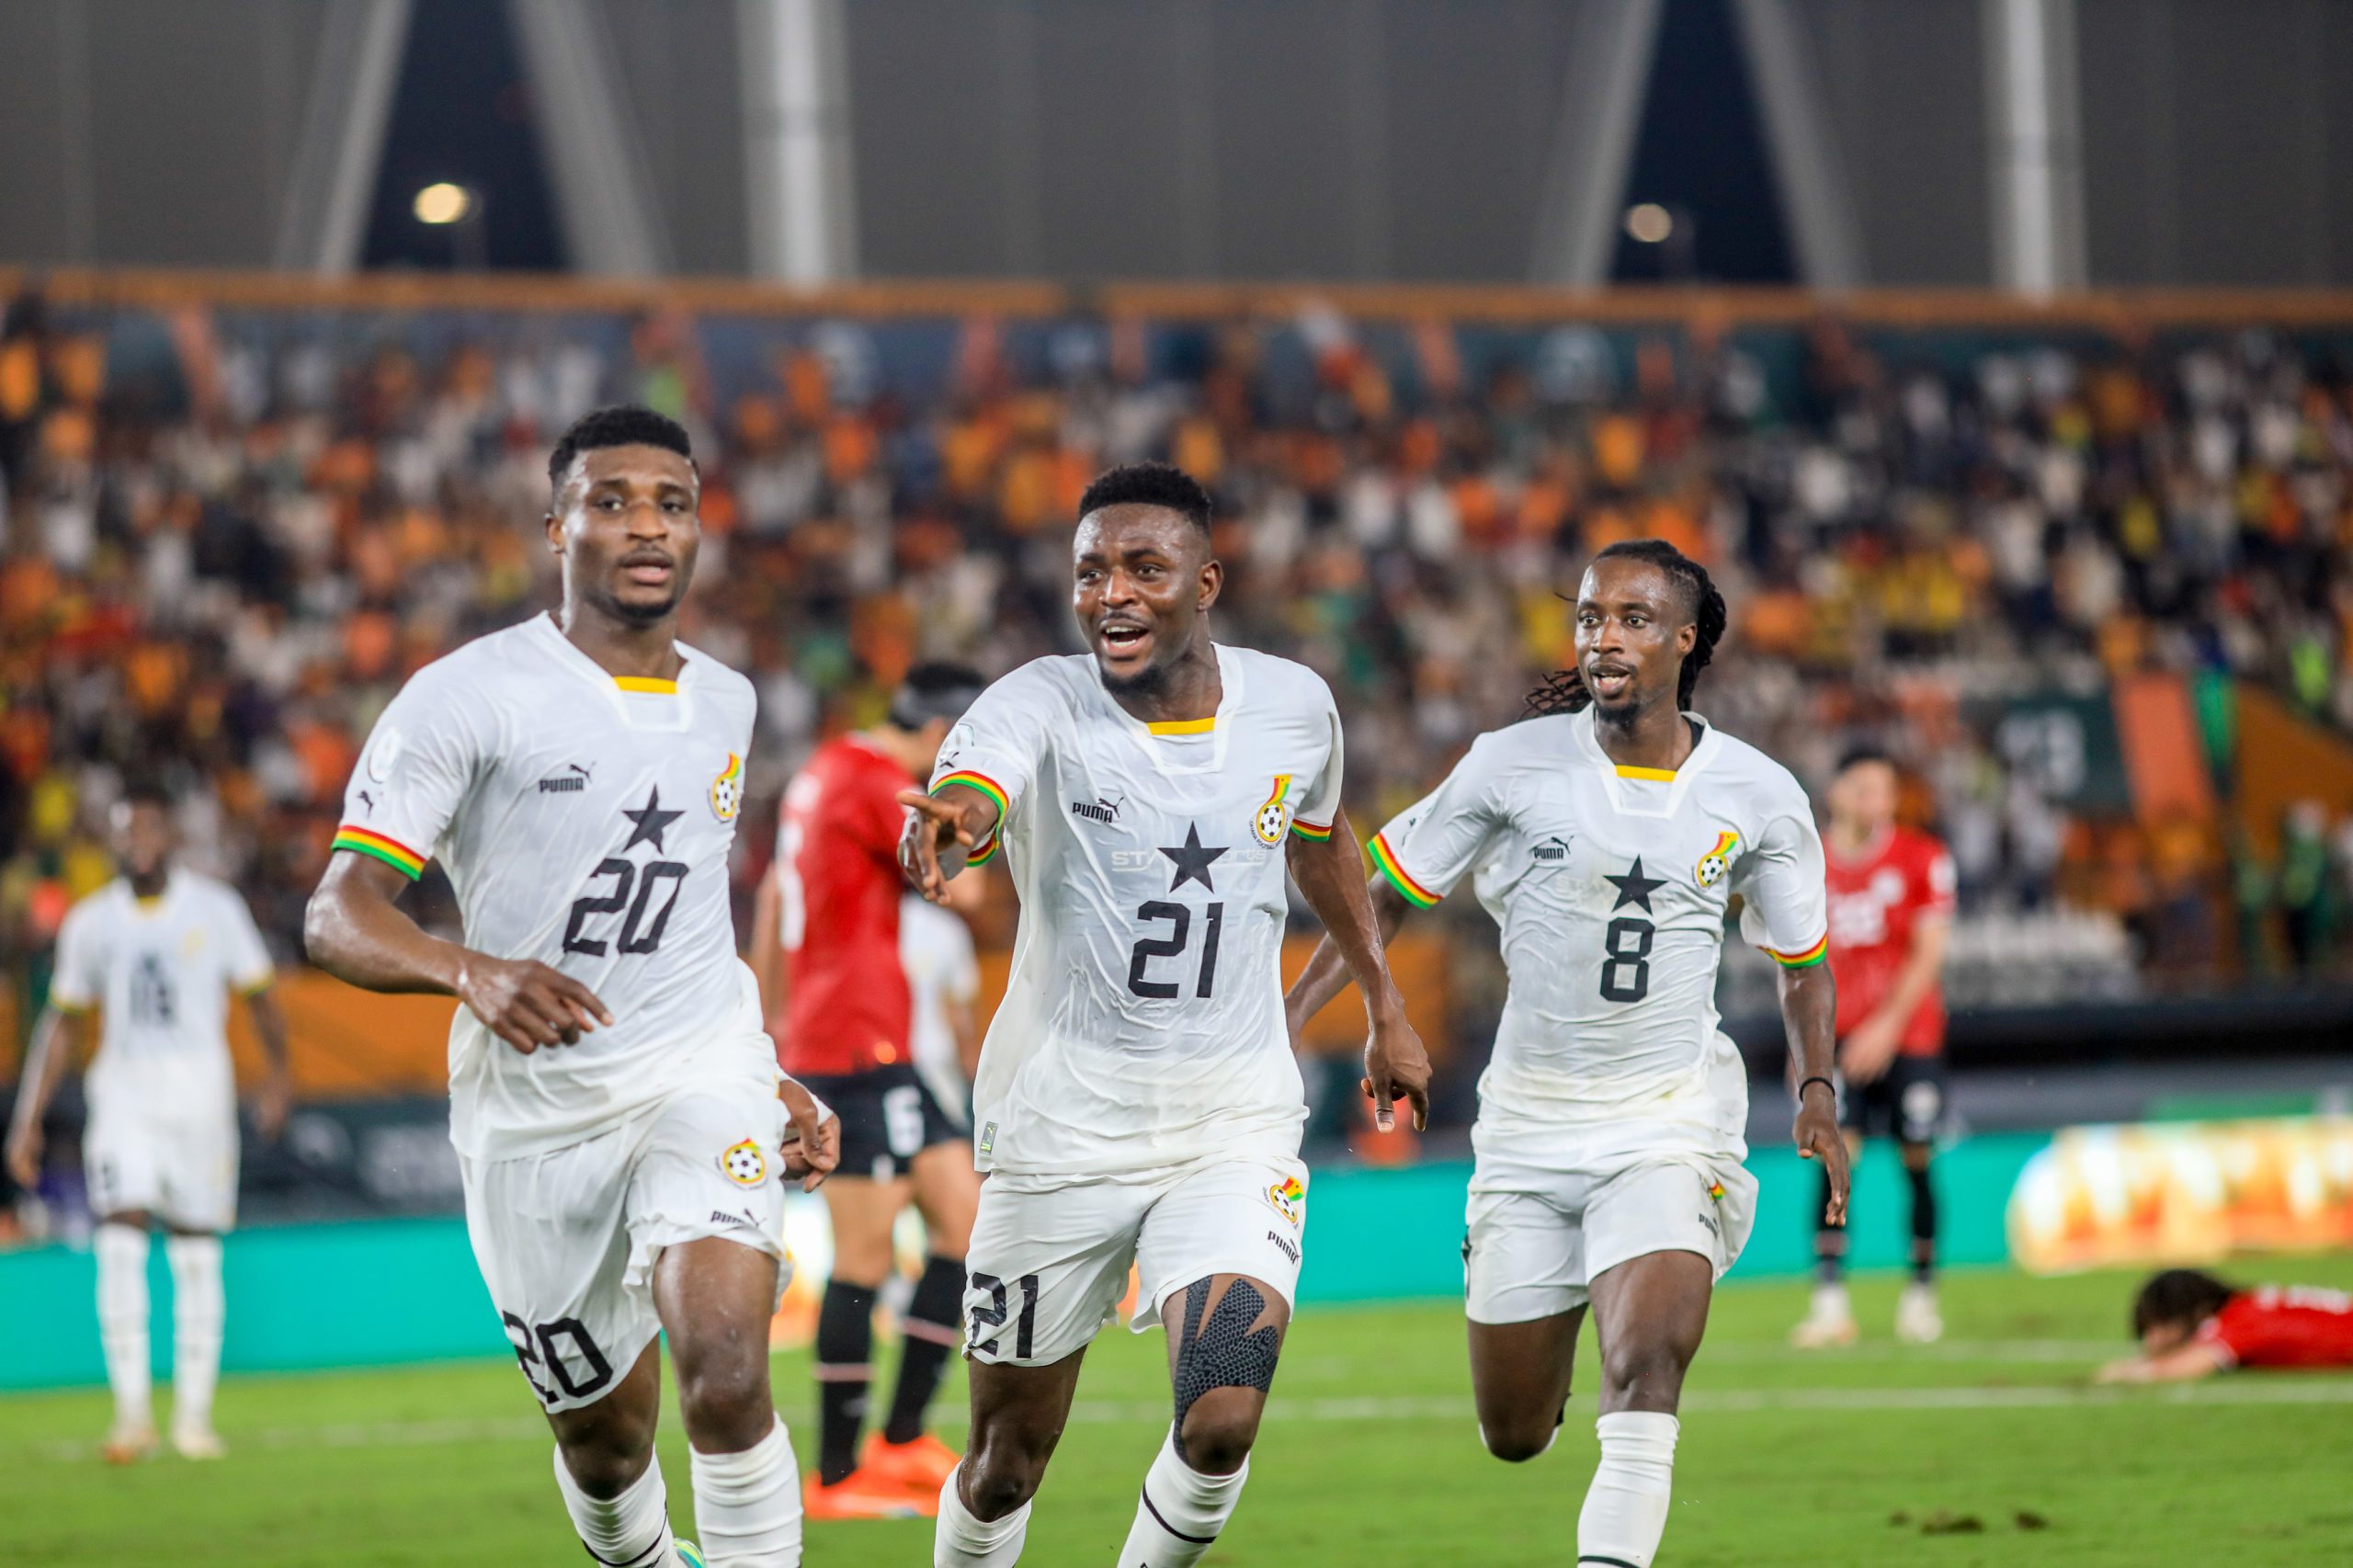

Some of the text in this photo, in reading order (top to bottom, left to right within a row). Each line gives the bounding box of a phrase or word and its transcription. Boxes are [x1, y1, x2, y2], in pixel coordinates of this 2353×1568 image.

[540, 778, 584, 793] PUMA
[1073, 801, 1114, 824] PUMA
[1533, 846, 1563, 860] PUMA
[562, 857, 690, 958] 20
[1128, 900, 1224, 999] 21
[1599, 916, 1655, 1003] 8
[1267, 1230, 1298, 1265] PUMA
[502, 1310, 614, 1404] 20
[967, 1271, 1039, 1358] 21
